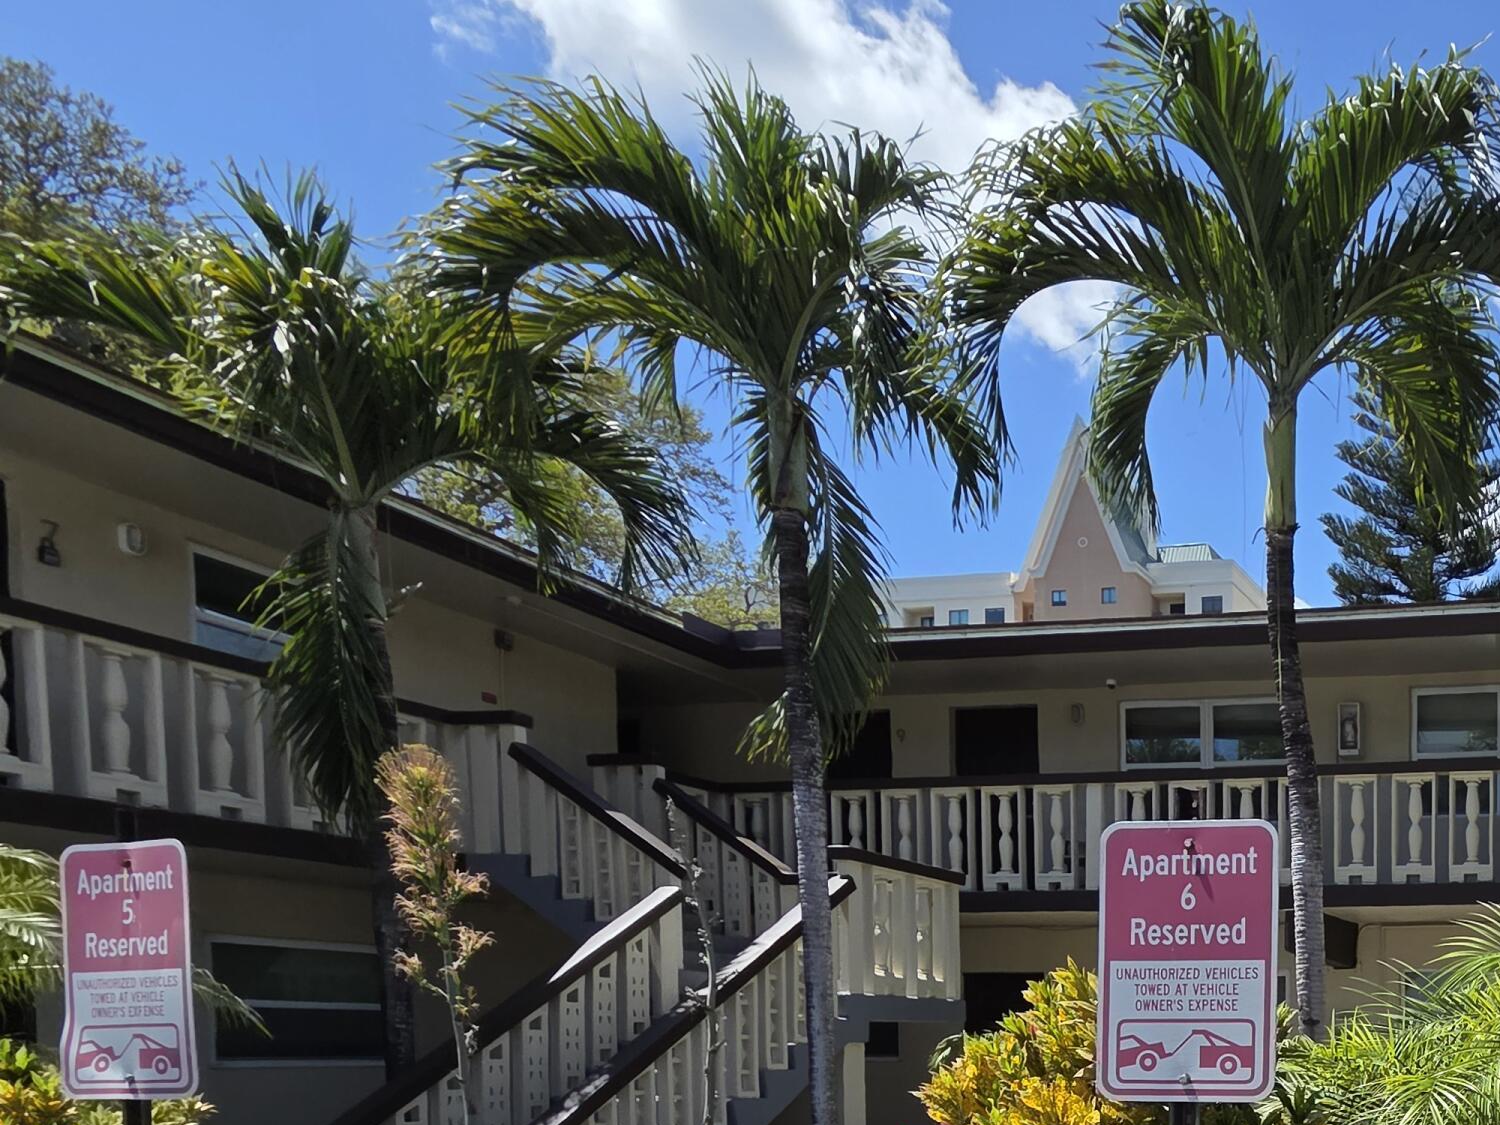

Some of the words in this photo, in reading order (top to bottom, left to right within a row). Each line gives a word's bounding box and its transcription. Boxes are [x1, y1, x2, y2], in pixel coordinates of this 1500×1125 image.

[1122, 846, 1257, 882] Apartment
[77, 864, 173, 899] Apartment
[1180, 883, 1196, 910] 6
[122, 899, 134, 925] 5
[1130, 917, 1246, 946] Reserved
[85, 929, 168, 958] Reserved
[77, 976, 137, 991] UNAUTHORIZED
[139, 975, 178, 988] VEHICLES
[1116, 967, 1200, 980] UNAUTHORIZED
[1205, 967, 1259, 980] VEHICLES
[90, 992, 116, 1005] TOWED
[118, 992, 128, 1004] AT
[130, 990, 164, 1003] VEHICLE
[1134, 983, 1170, 996] TOWED
[1174, 983, 1188, 996] AT
[1192, 983, 1239, 996] VEHICLE
[91, 1006, 126, 1019] OWNER'S
[128, 1004, 165, 1018] EXPENSE
[1135, 999, 1183, 1012] OWNER'S
[1188, 999, 1238, 1012] EXPENSE
